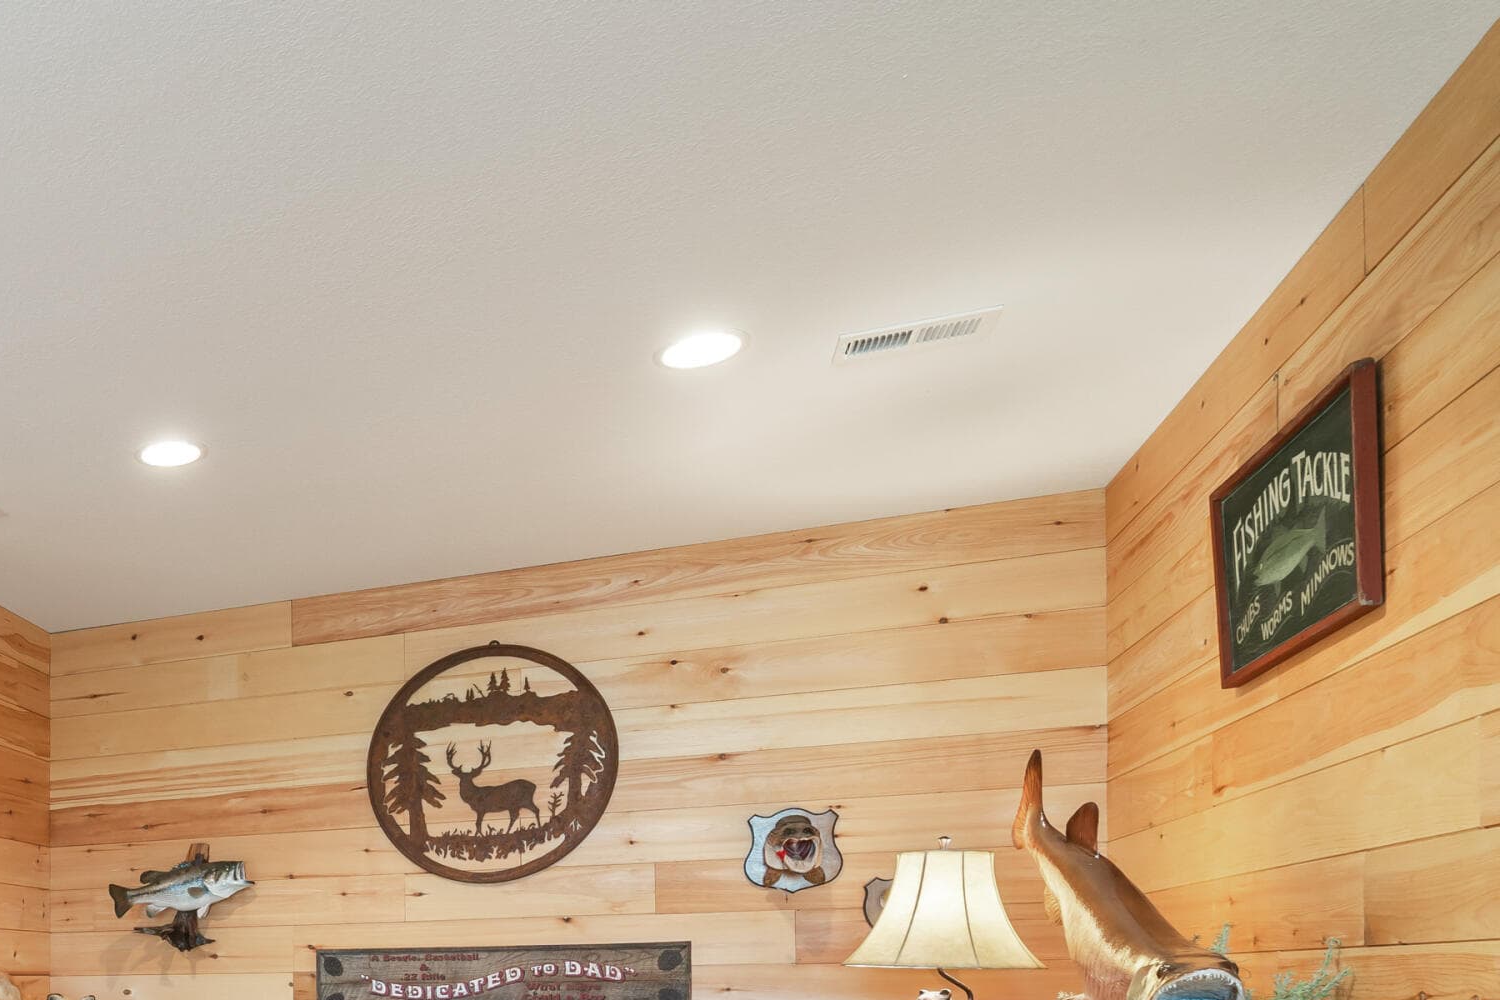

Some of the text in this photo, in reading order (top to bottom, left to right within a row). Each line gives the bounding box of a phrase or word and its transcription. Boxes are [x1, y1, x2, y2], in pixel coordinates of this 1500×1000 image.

[1232, 449, 1351, 594] FISHING TACKLE
[1236, 541, 1355, 645] CHUBS WORMS MINNOWS
